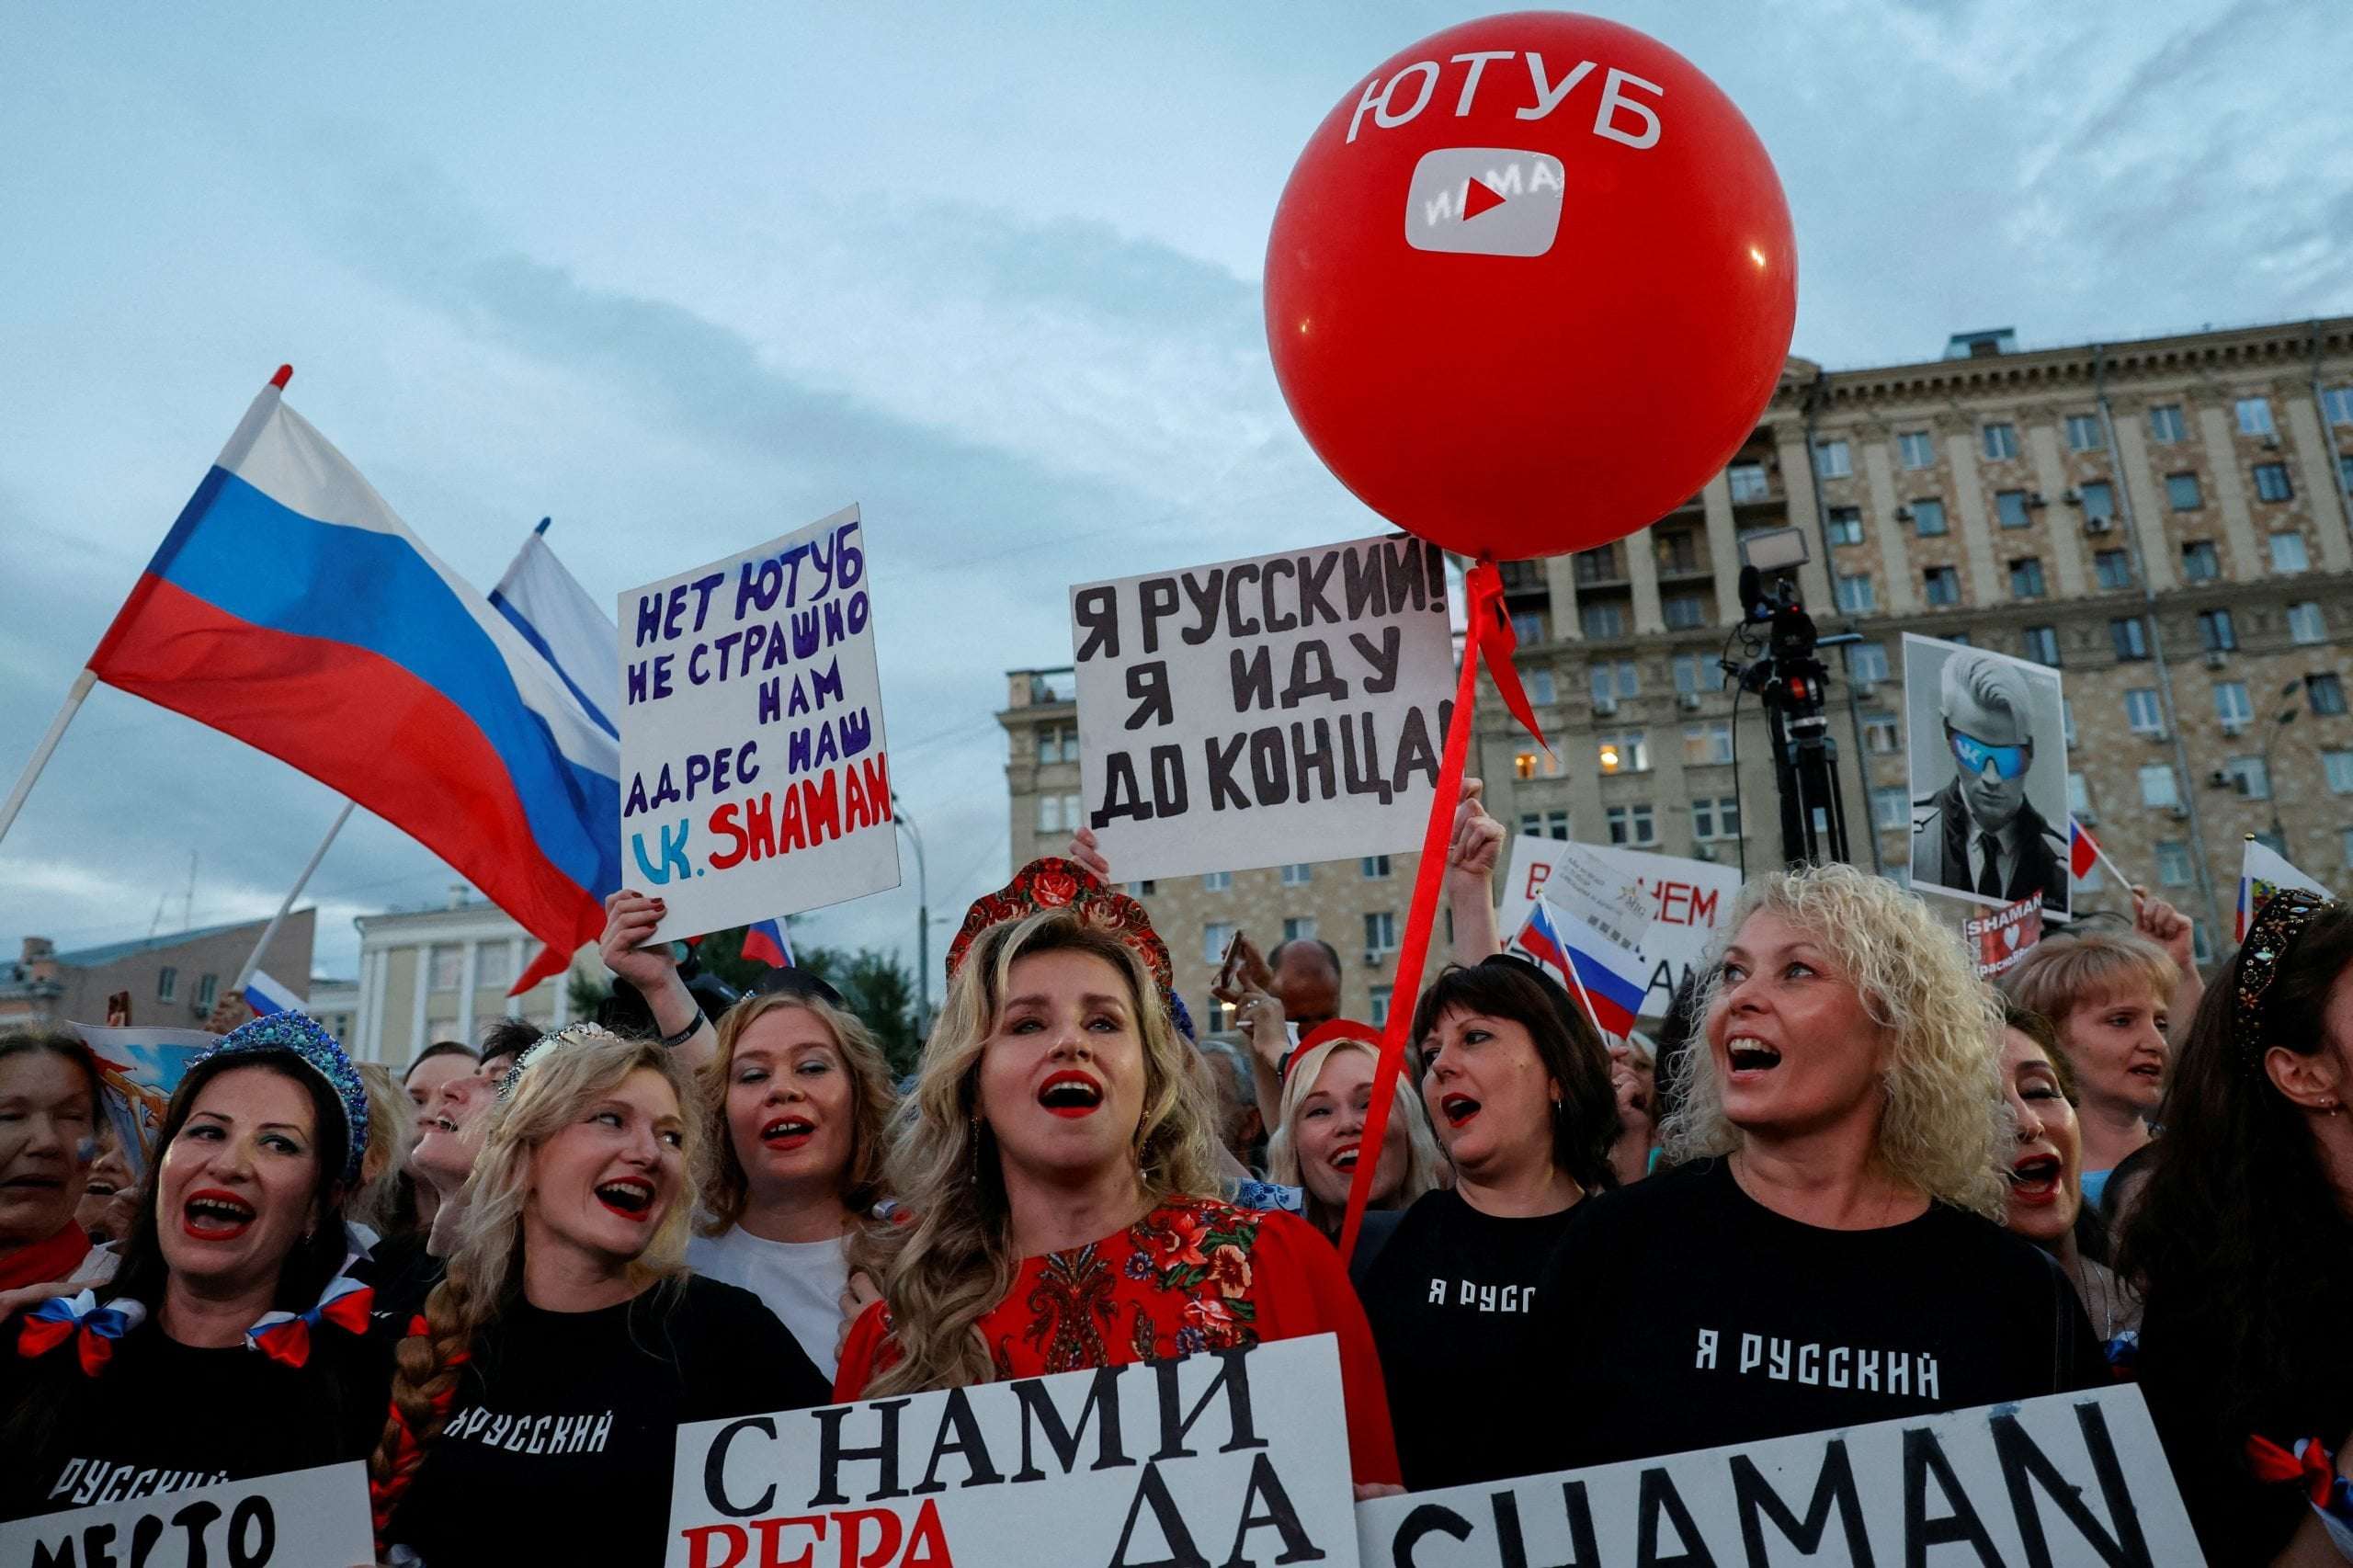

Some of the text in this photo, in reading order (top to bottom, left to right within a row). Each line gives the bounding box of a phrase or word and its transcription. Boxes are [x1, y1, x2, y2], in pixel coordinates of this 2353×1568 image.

[1346, 51, 1664, 150] ЮТУБ
[637, 522, 863, 647] НЕТ ЮТУБ
[1075, 531, 1446, 662] Я РУССКИЙ!
[628, 591, 869, 705] НЕ СТРАШНО
[758, 655, 844, 724] НАМ
[1124, 626, 1401, 731] Я ИДУ
[623, 707, 871, 818] АДРЕС НАШ
[1091, 744, 1188, 830] ДО
[1968, 892, 2042, 936] SHAMAN
[1428, 1278, 1536, 1312] Я РУСС
[1695, 1328, 1939, 1400] Я РУССКИЙ
